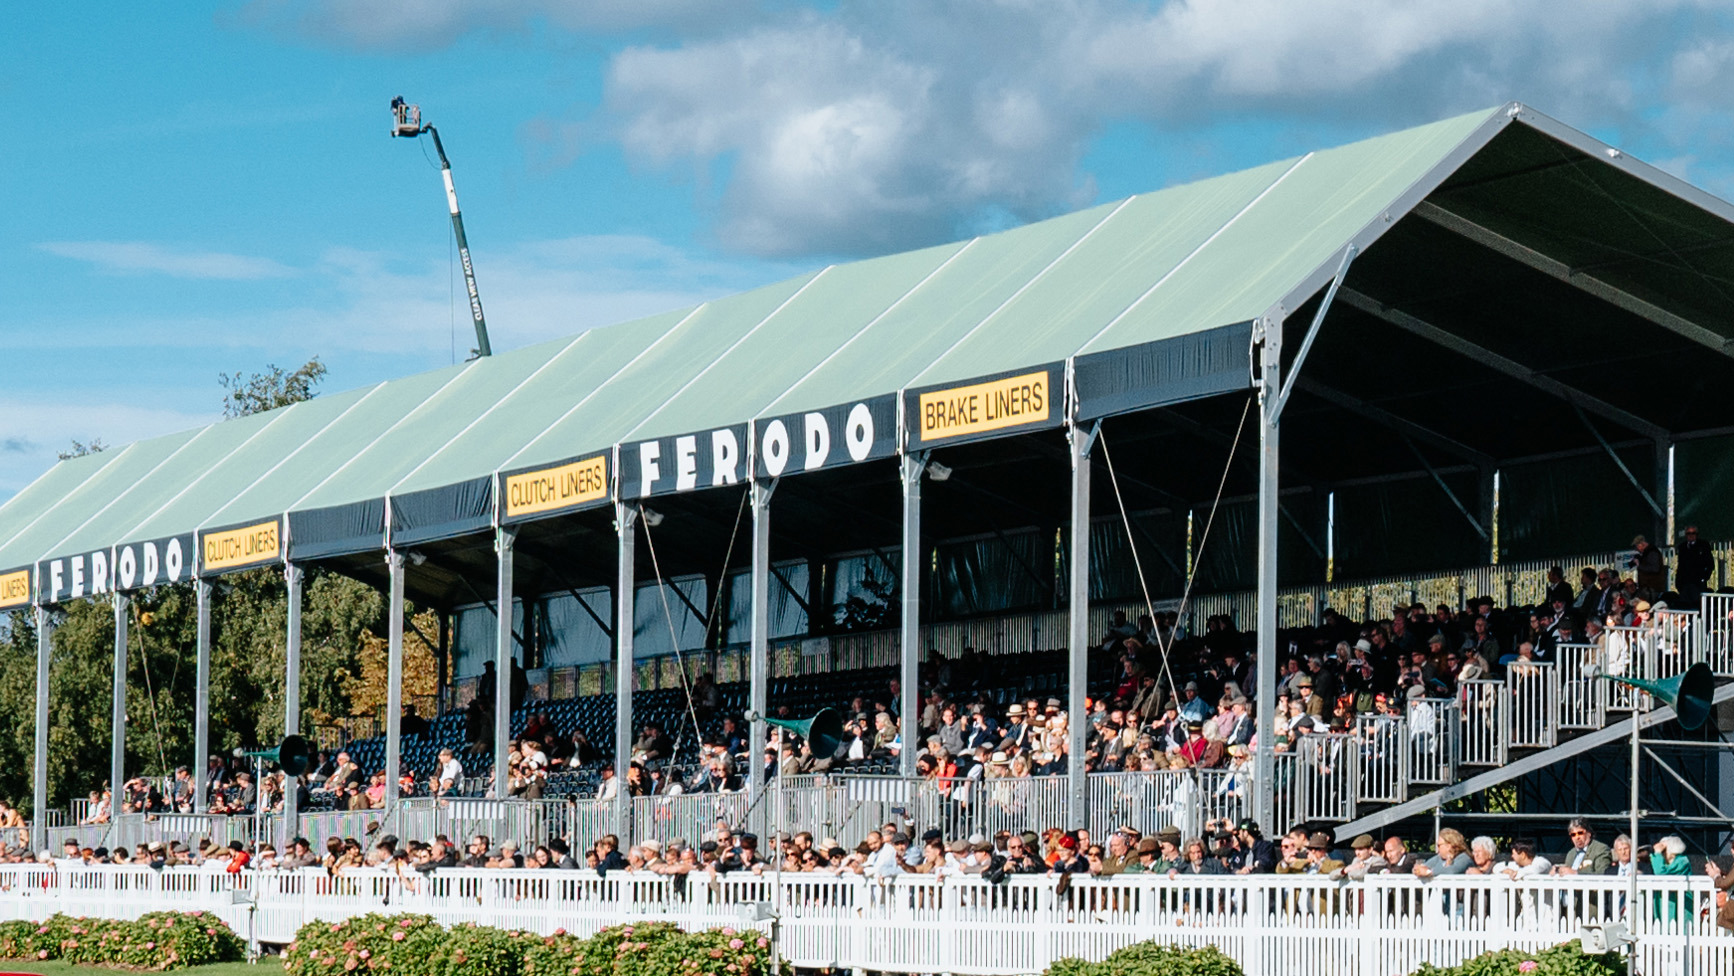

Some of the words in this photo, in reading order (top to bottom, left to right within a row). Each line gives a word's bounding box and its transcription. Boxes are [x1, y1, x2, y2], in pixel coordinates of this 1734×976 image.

[460, 247, 473, 276] ACCESS
[926, 395, 978, 431] BRAKE
[985, 382, 1044, 421] LINERS
[639, 402, 874, 499] FERODO
[511, 478, 555, 508] CLUTCH
[561, 465, 603, 498] LINERS
[207, 536, 242, 562] CLUTCH
[245, 528, 276, 554] LINERS
[1, 577, 27, 600] LINERS
[50, 537, 183, 603] FERODO
